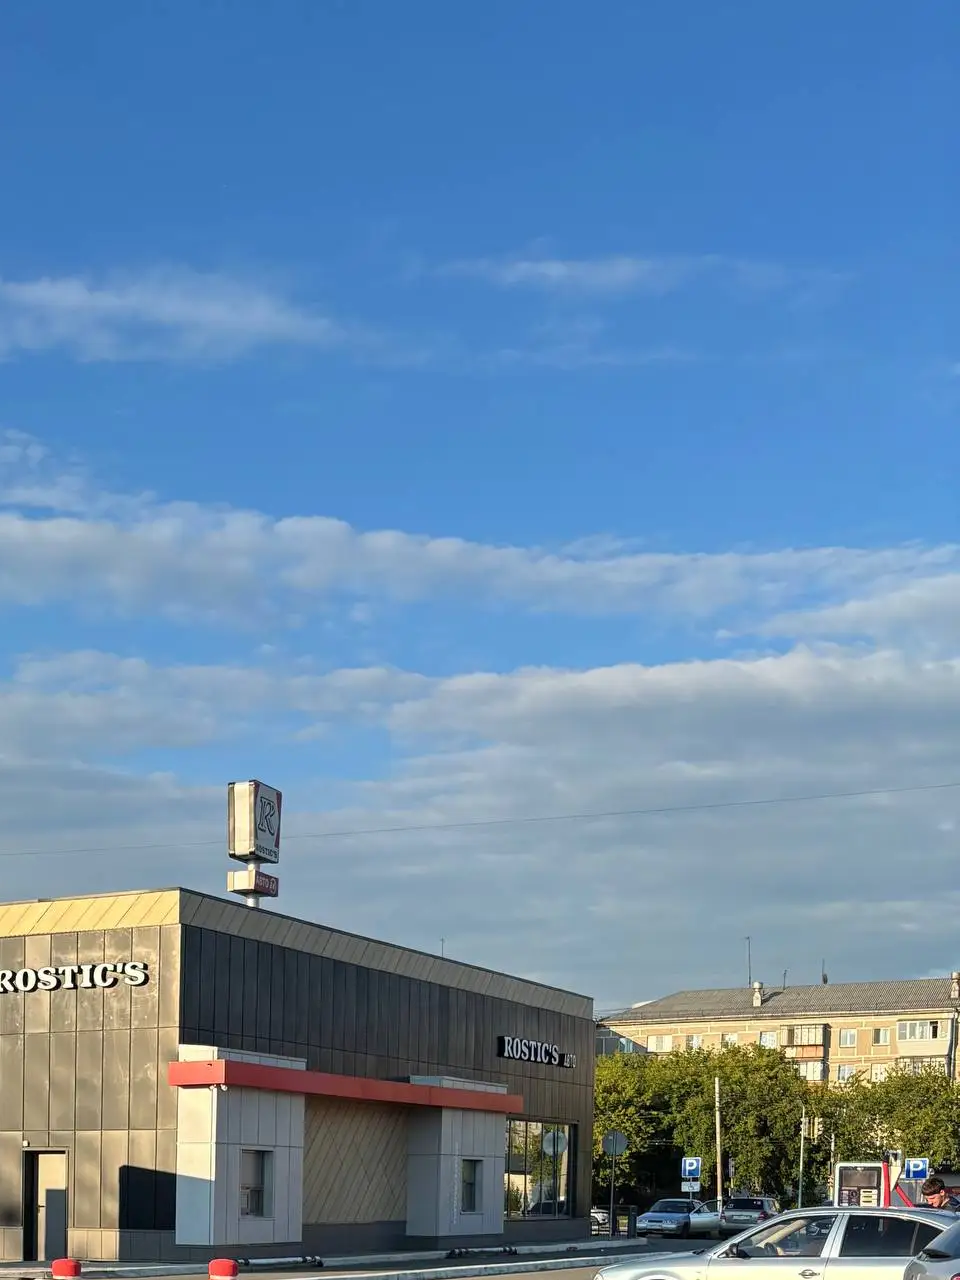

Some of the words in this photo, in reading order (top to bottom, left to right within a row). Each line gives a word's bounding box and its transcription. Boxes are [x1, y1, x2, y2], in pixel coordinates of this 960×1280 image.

[258, 796, 275, 836] R
[503, 1036, 559, 1065] ROSTIC'S
[685, 1159, 697, 1176] P
[909, 1160, 923, 1177] P
